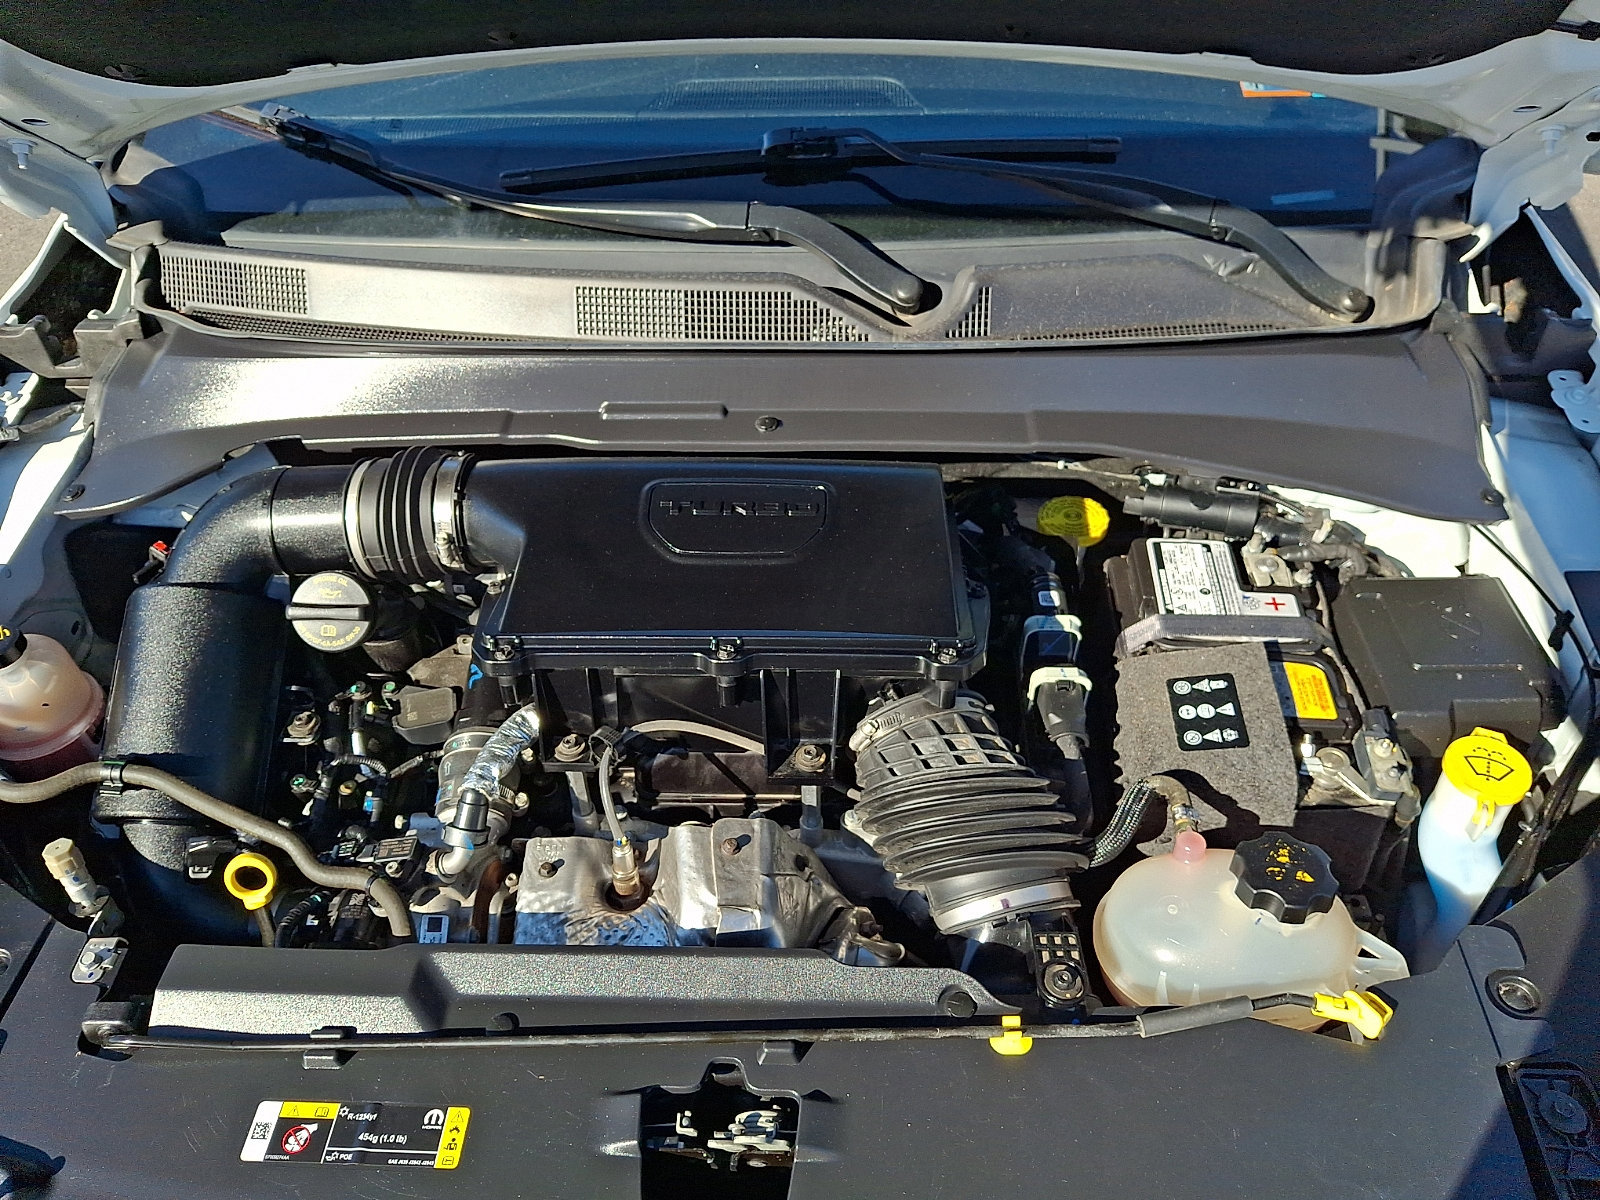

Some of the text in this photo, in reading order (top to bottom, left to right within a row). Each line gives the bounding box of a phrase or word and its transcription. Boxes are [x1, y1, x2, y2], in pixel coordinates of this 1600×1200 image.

[313, 577, 348, 587] ENGINE OIL
[358, 1132, 408, 1146] 454g (1.0 lb)
